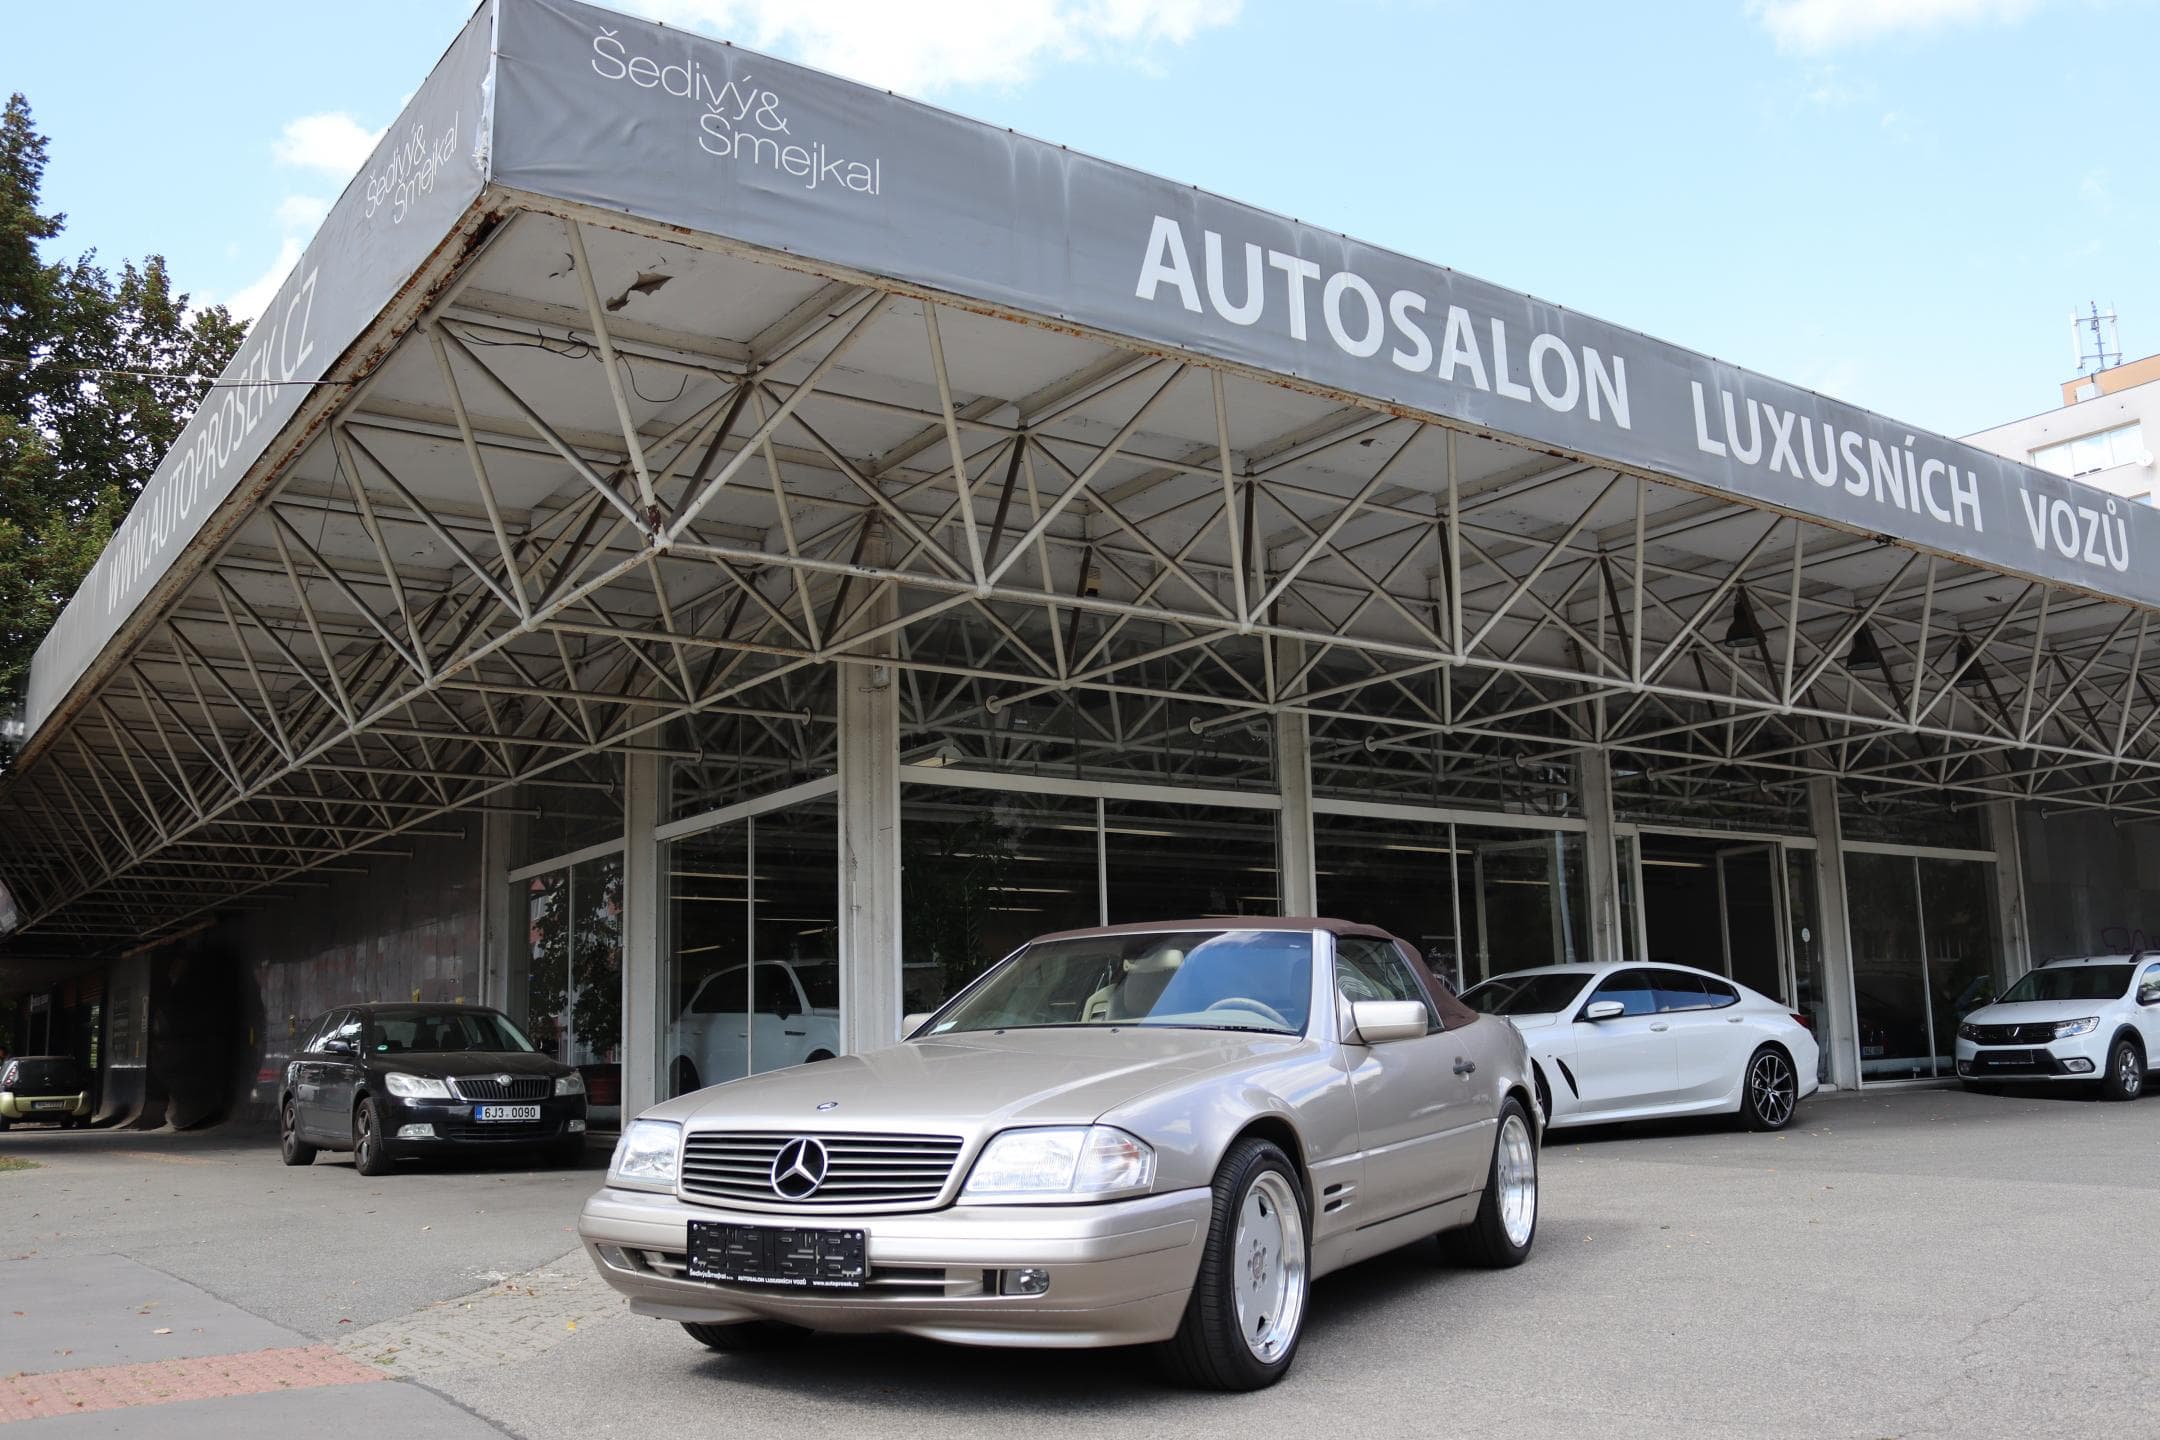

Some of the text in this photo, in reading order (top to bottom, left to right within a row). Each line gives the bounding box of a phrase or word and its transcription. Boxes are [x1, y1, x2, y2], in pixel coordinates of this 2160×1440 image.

[591, 26, 791, 135] Šedivý&
[365, 121, 426, 219] Šedivý&
[394, 110, 459, 224] Šmejkal
[699, 103, 880, 195] Šmejkal
[107, 265, 319, 616] WWW.AUTOPROSEK.CZ
[1135, 214, 2130, 573] AUTOSALON LUXUSNÍCH VOZŮ
[484, 1107, 536, 1118] 6J3 0090
